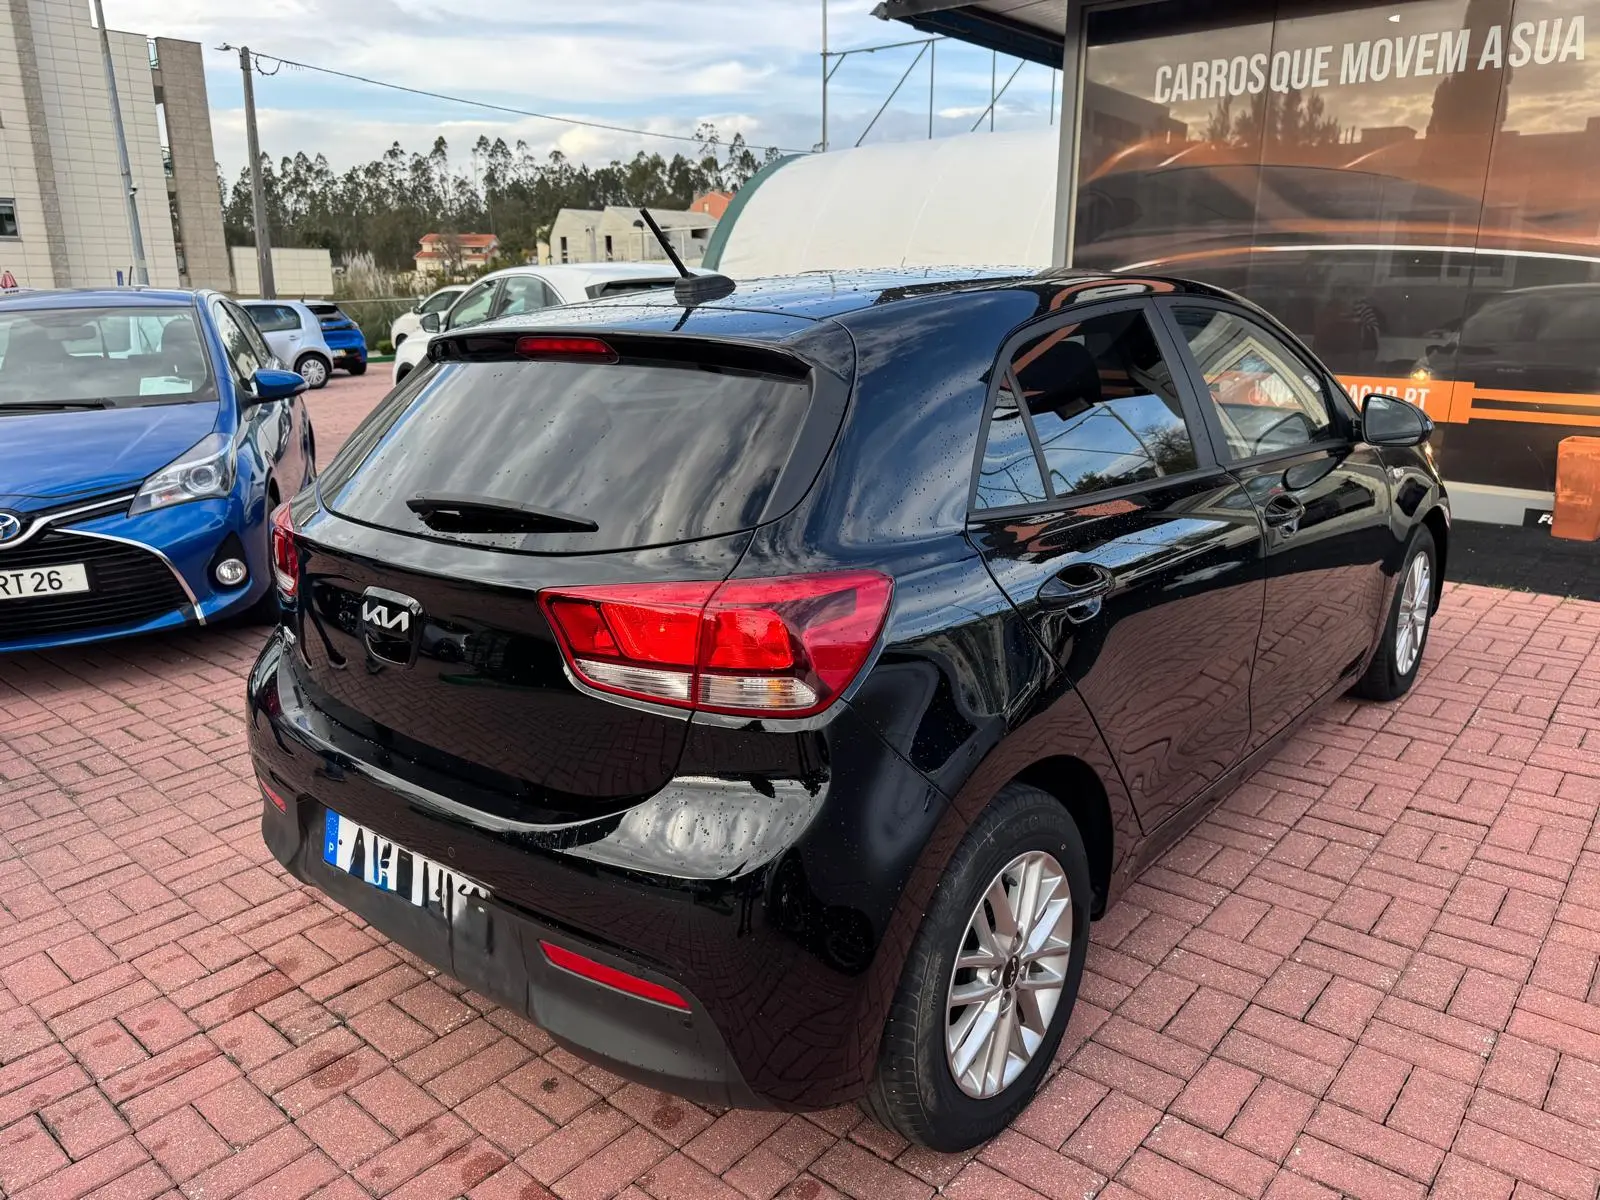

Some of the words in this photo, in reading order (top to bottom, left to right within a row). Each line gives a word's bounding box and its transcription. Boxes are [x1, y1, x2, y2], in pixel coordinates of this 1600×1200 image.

[1154, 53, 1267, 104] CARROS
[1270, 45, 1333, 94] QUE
[1339, 28, 1471, 85] MOVEM
[1477, 25, 1502, 71] A
[1508, 15, 1585, 68] SUA
[31, 570, 63, 592] 26
[362, 600, 409, 632] KIA
